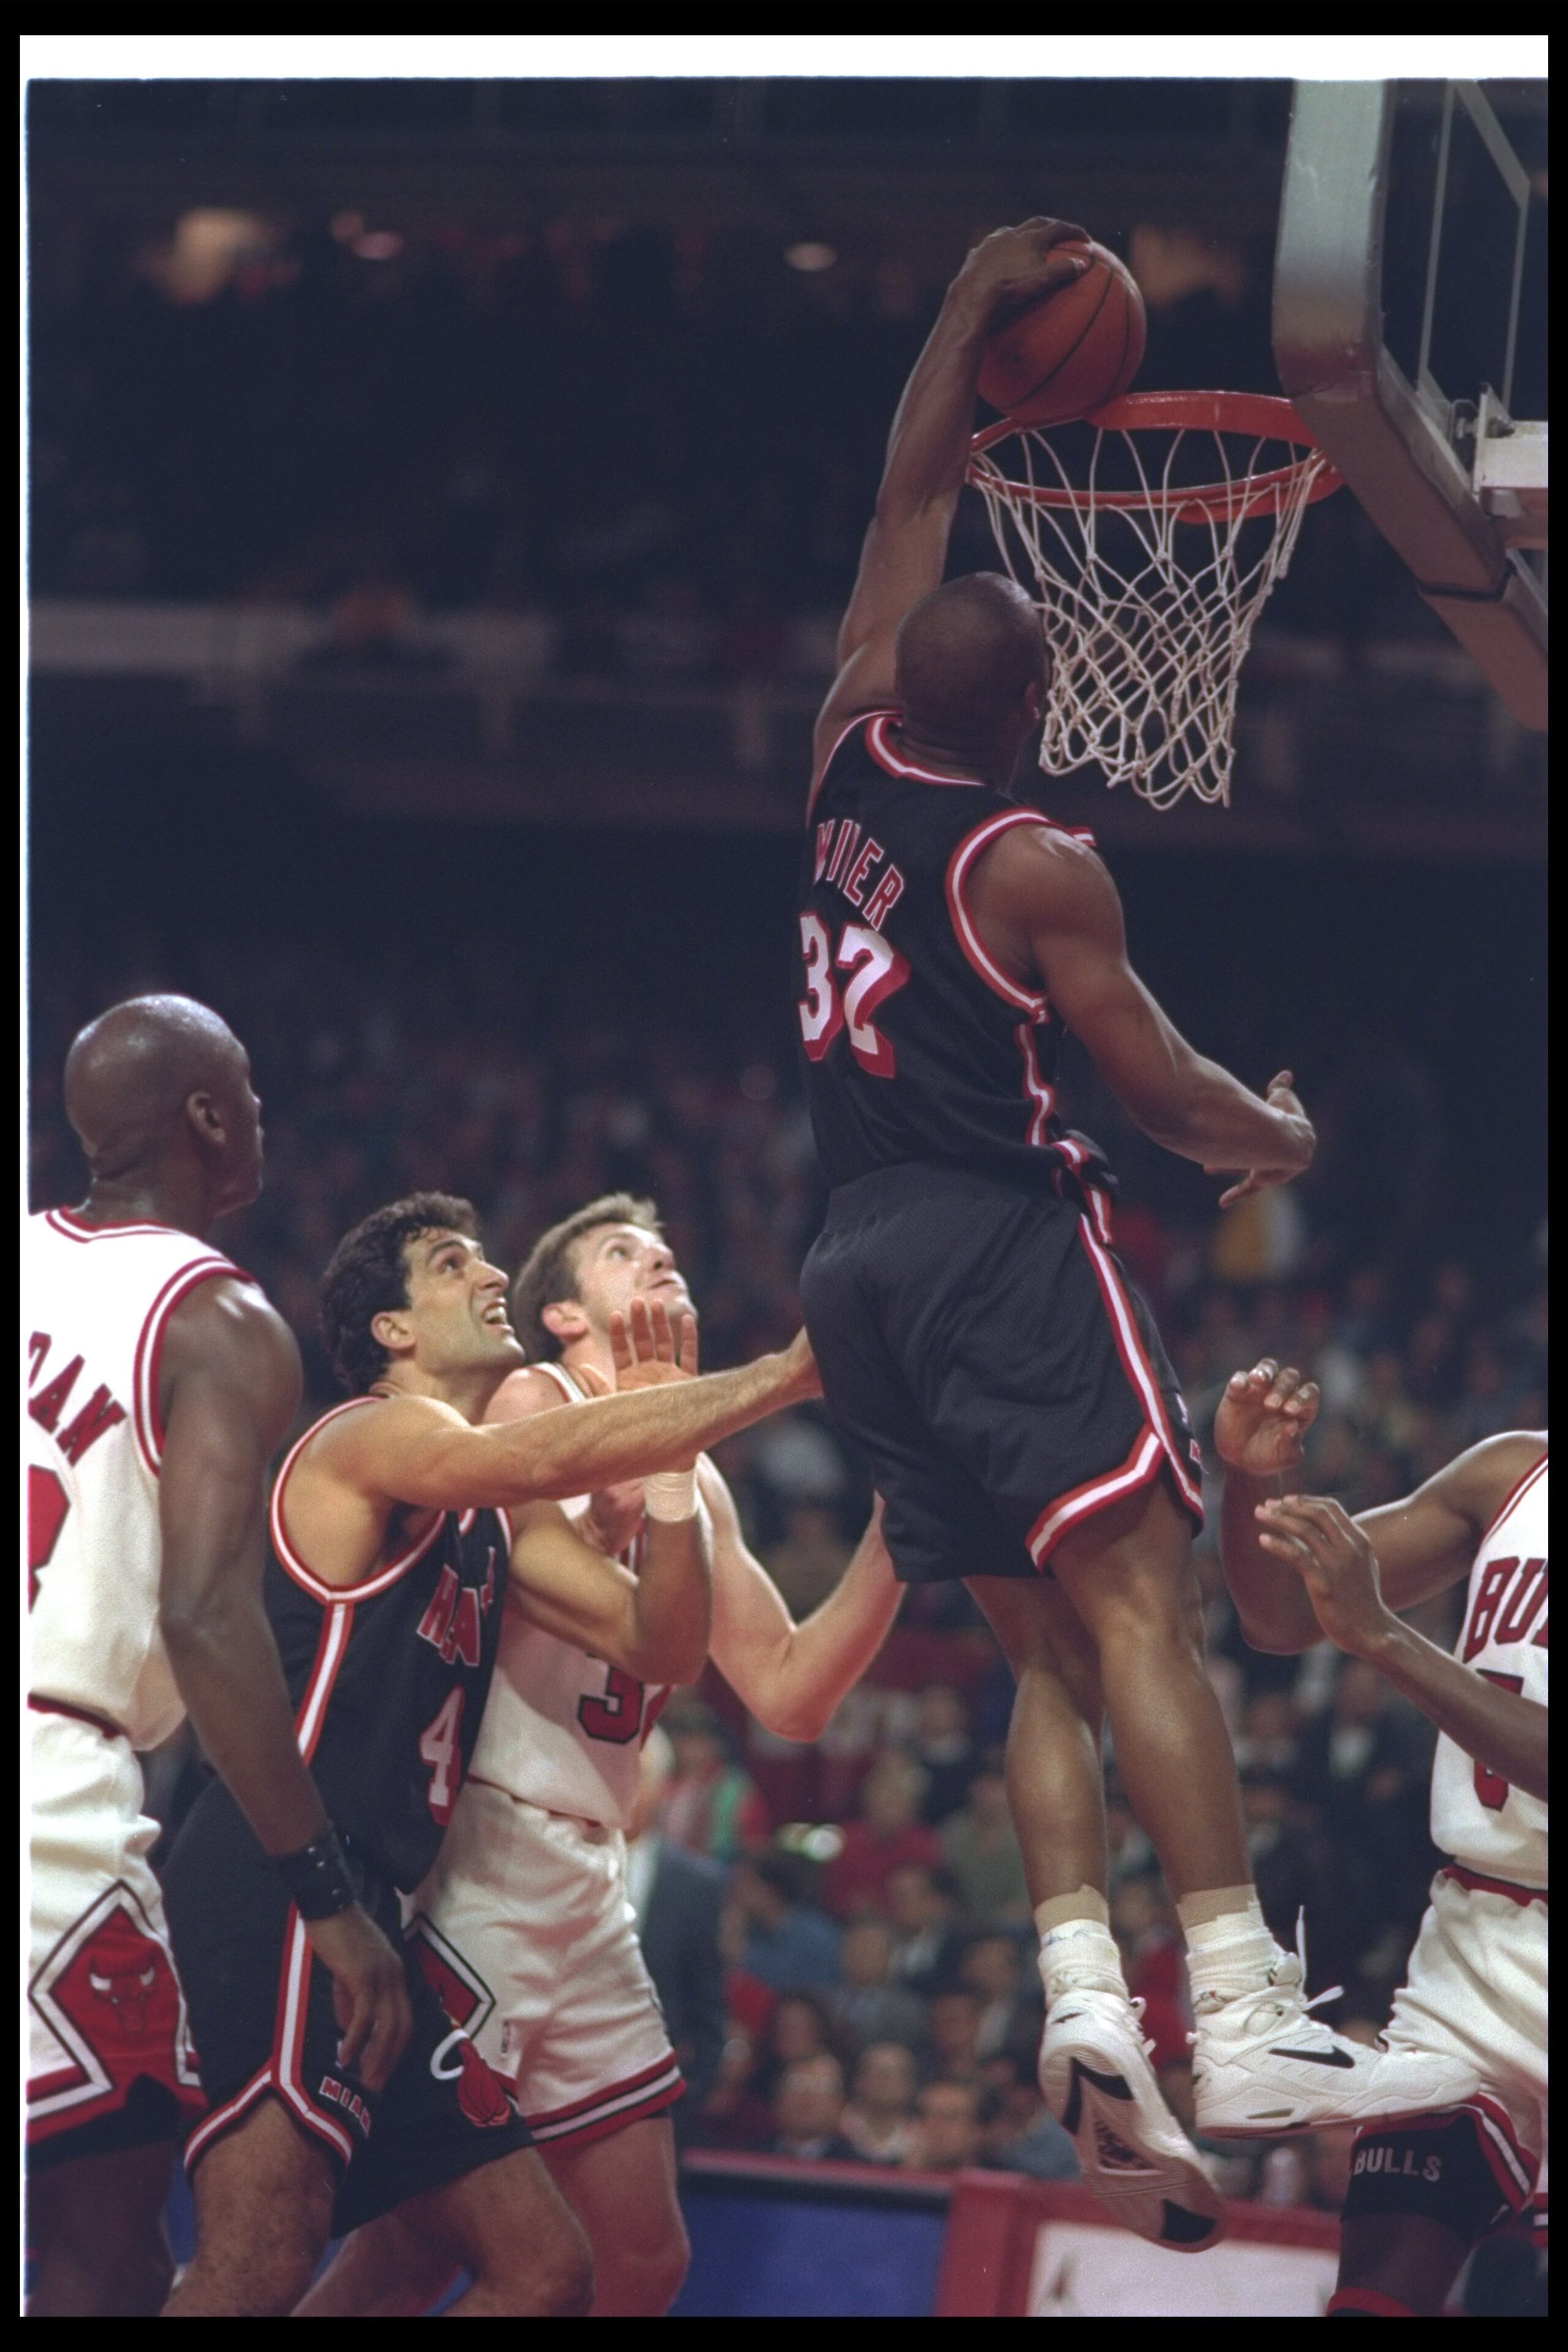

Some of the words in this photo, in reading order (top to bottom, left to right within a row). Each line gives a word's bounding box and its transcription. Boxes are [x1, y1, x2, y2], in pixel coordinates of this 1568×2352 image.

[814, 818, 904, 932] IER
[799, 911, 911, 1080] 32
[1463, 1556, 1548, 1664] BU
[420, 1684, 463, 1826] 4
[577, 1653, 673, 1752] 3
[1354, 2147, 1442, 2182] BULLS
